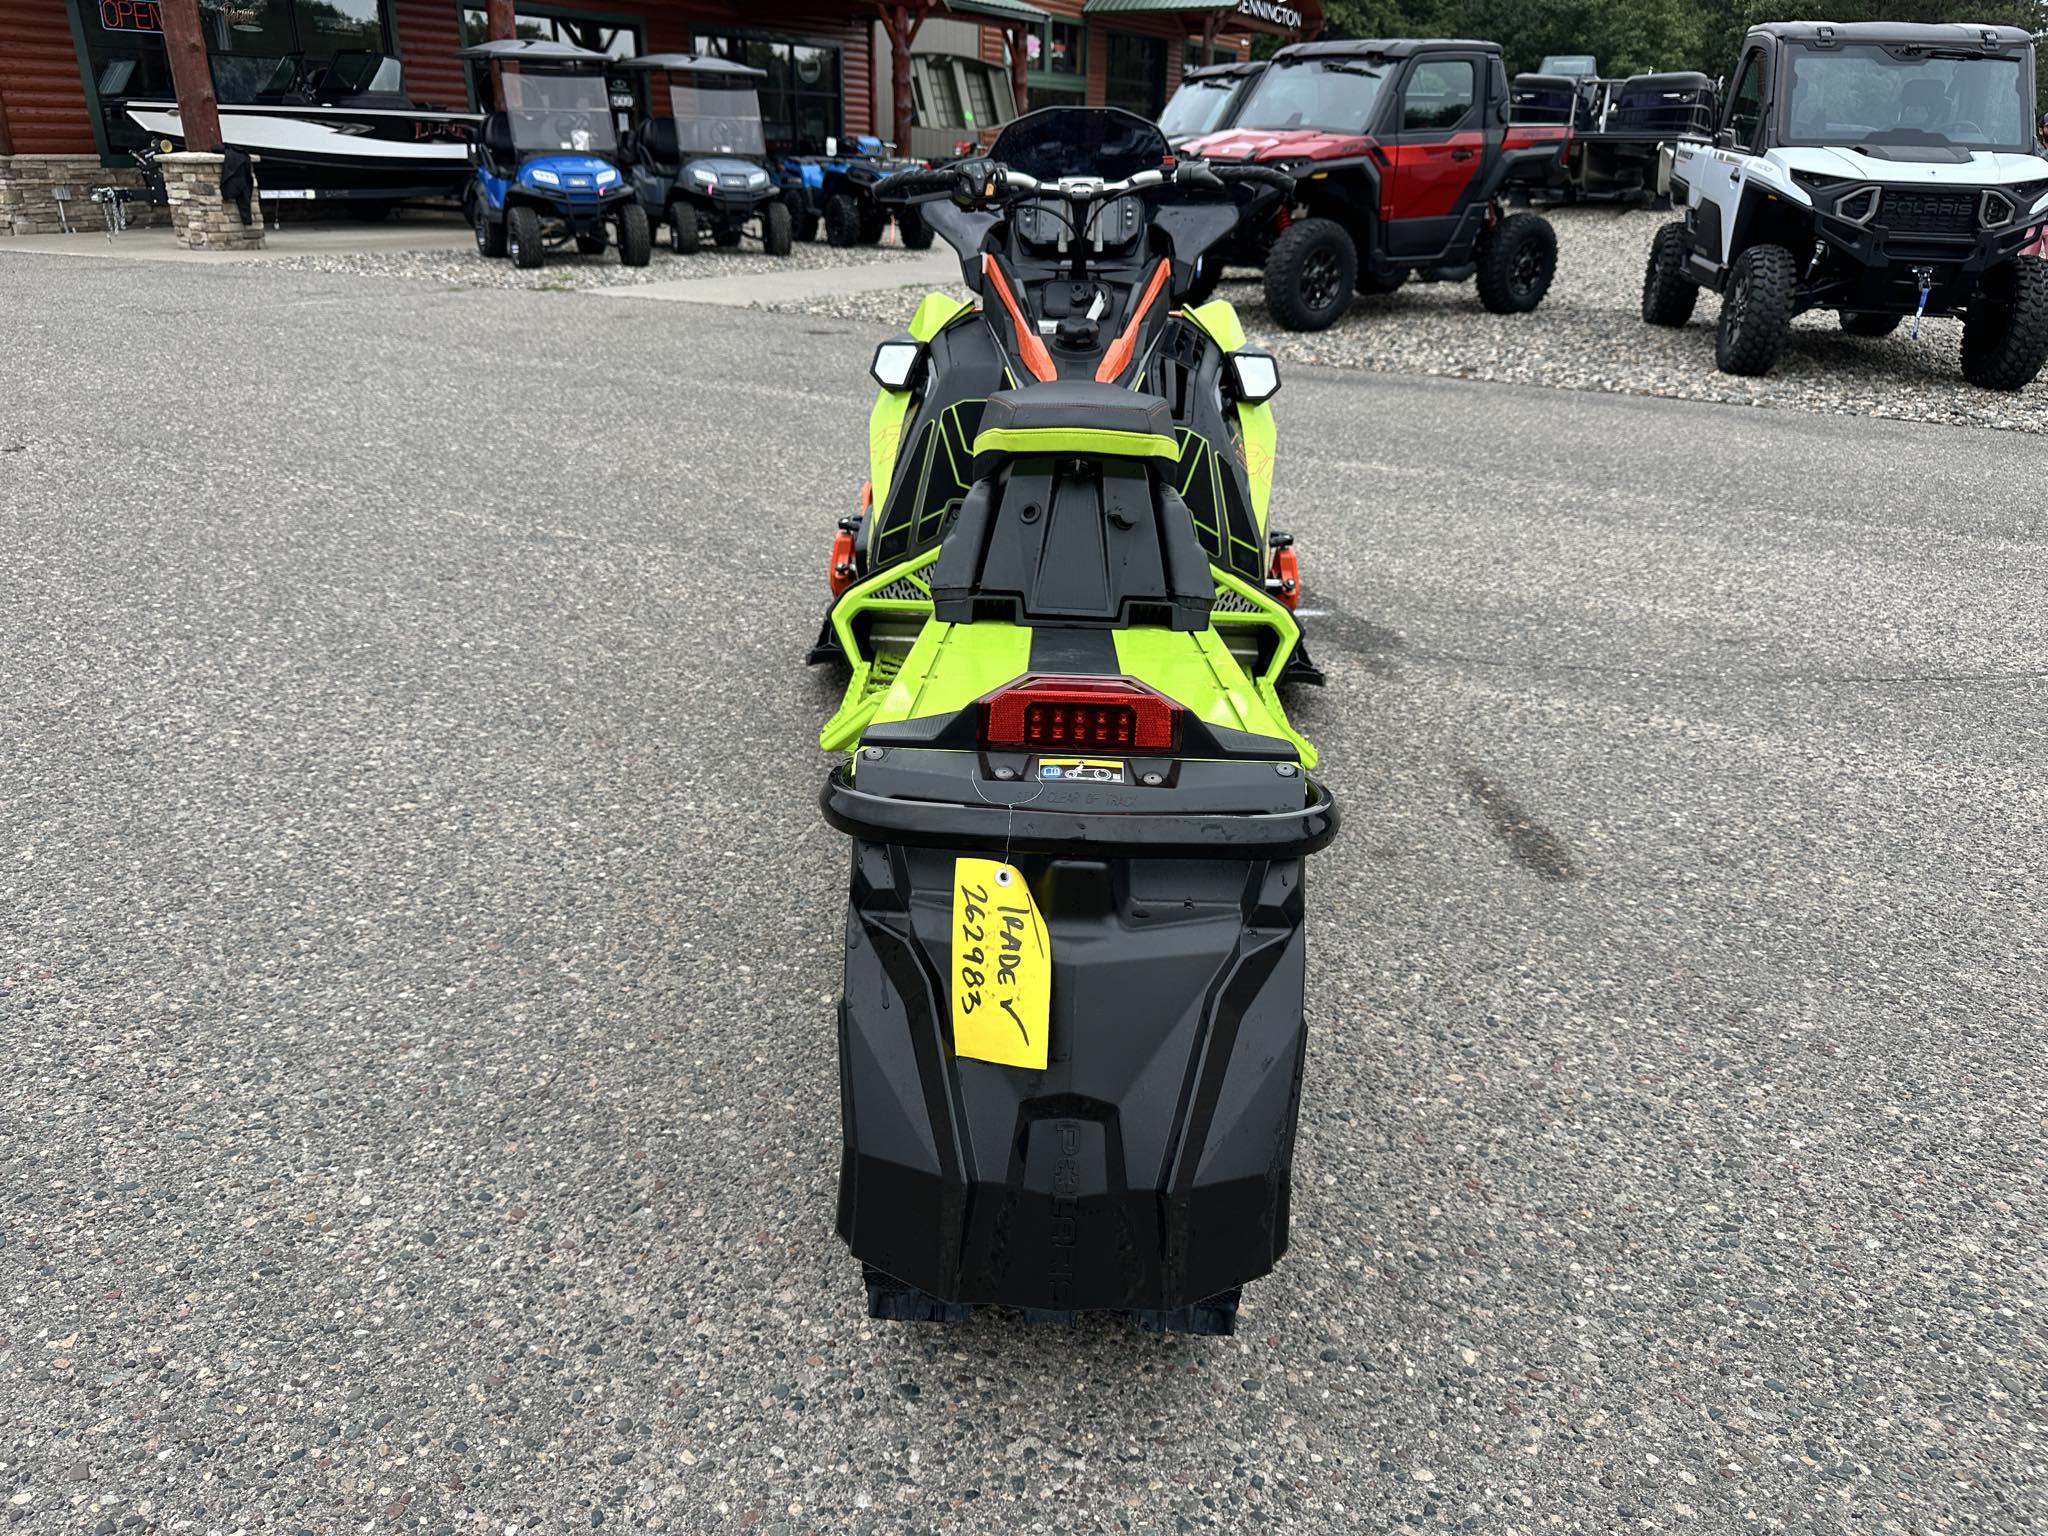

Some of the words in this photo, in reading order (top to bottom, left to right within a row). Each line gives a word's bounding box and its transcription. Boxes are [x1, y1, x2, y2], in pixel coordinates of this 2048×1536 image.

[1238, 0, 1302, 27] ENNINGTON
[1882, 200, 1974, 216] POLARIS
[961, 884, 989, 1015] 262983
[997, 892, 1045, 986] TRADE
